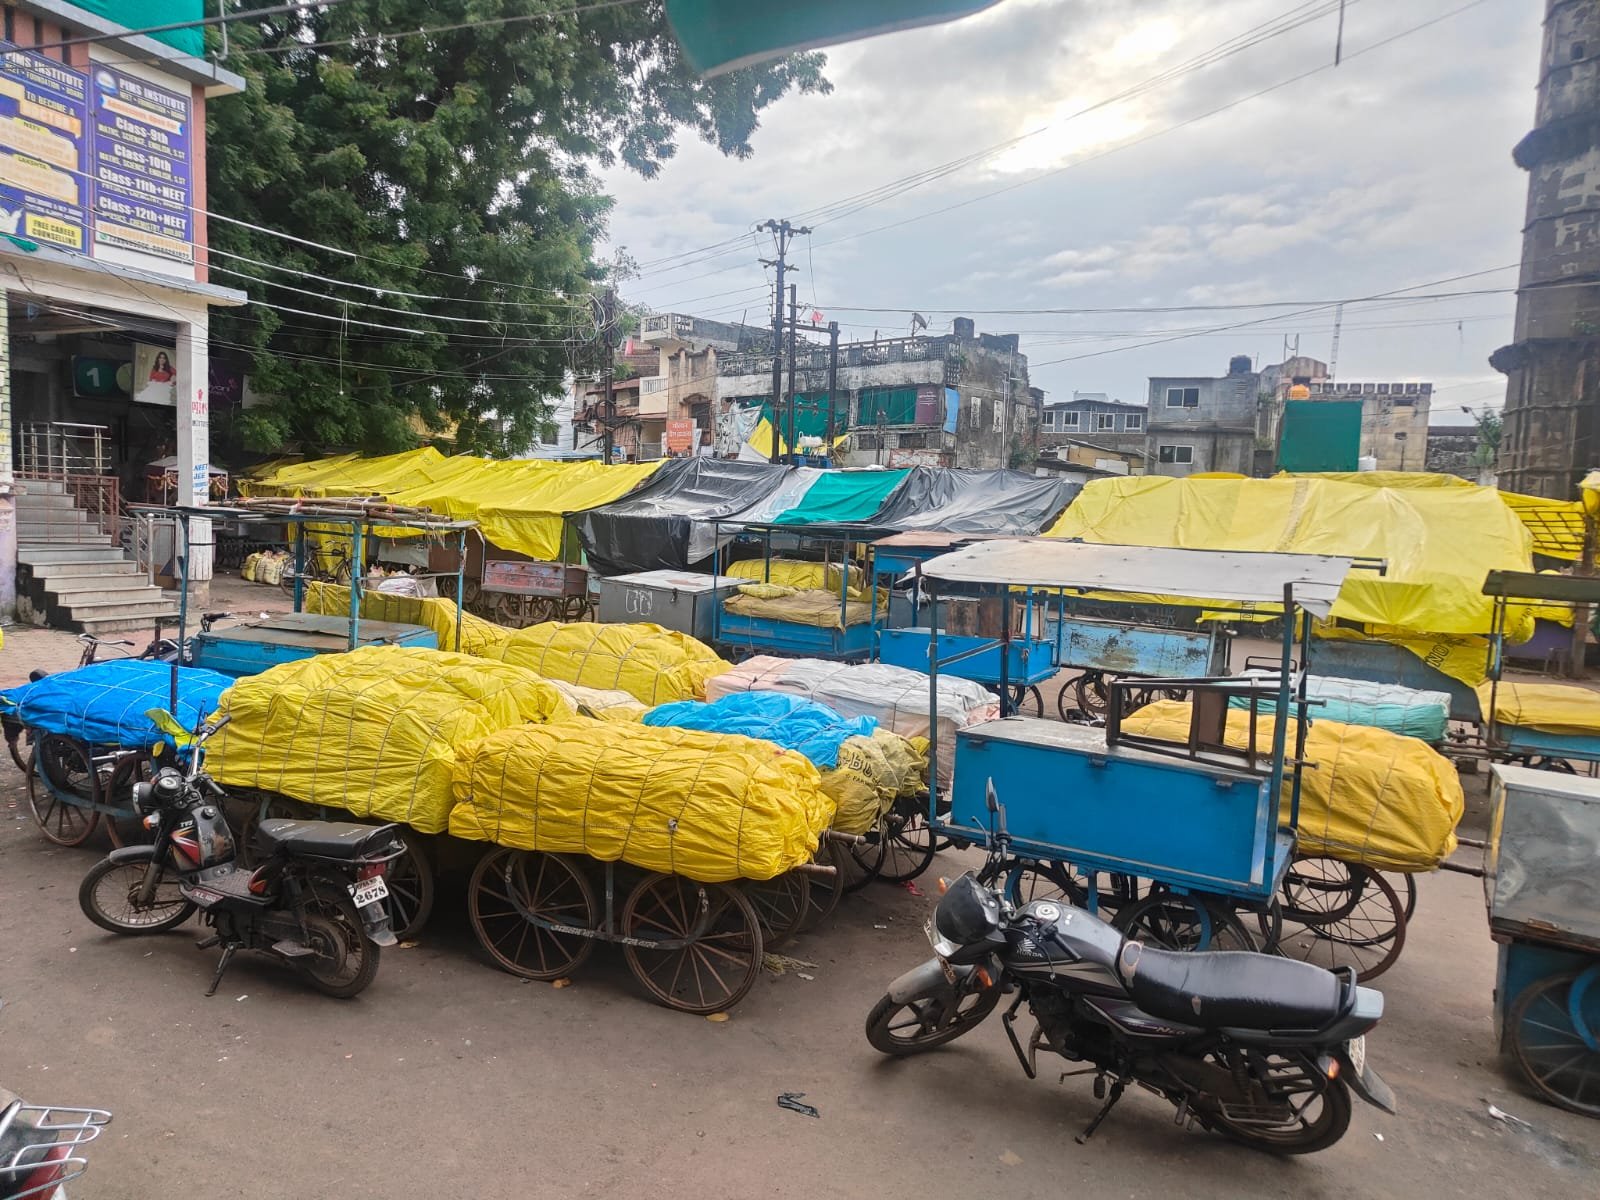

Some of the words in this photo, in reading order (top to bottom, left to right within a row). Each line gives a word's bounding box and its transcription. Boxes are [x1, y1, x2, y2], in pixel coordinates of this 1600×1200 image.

[34, 60, 84, 90] INSTITUTE
[26, 90, 36, 102] TO
[38, 95, 68, 113] BECOME
[69, 107, 75, 116] A
[119, 78, 142, 96] PIMS
[143, 87, 186, 113] INSTITUTE
[115, 116, 169, 145] Class-9th
[113, 143, 172, 173] Class-10th
[99, 196, 187, 230] Class-12th+NEET
[33, 219, 49, 231] FREE
[51, 224, 76, 238] CAREER
[86, 367, 100, 388] 1
[180, 820, 194, 828] TVS
[355, 886, 386, 904] 2678
